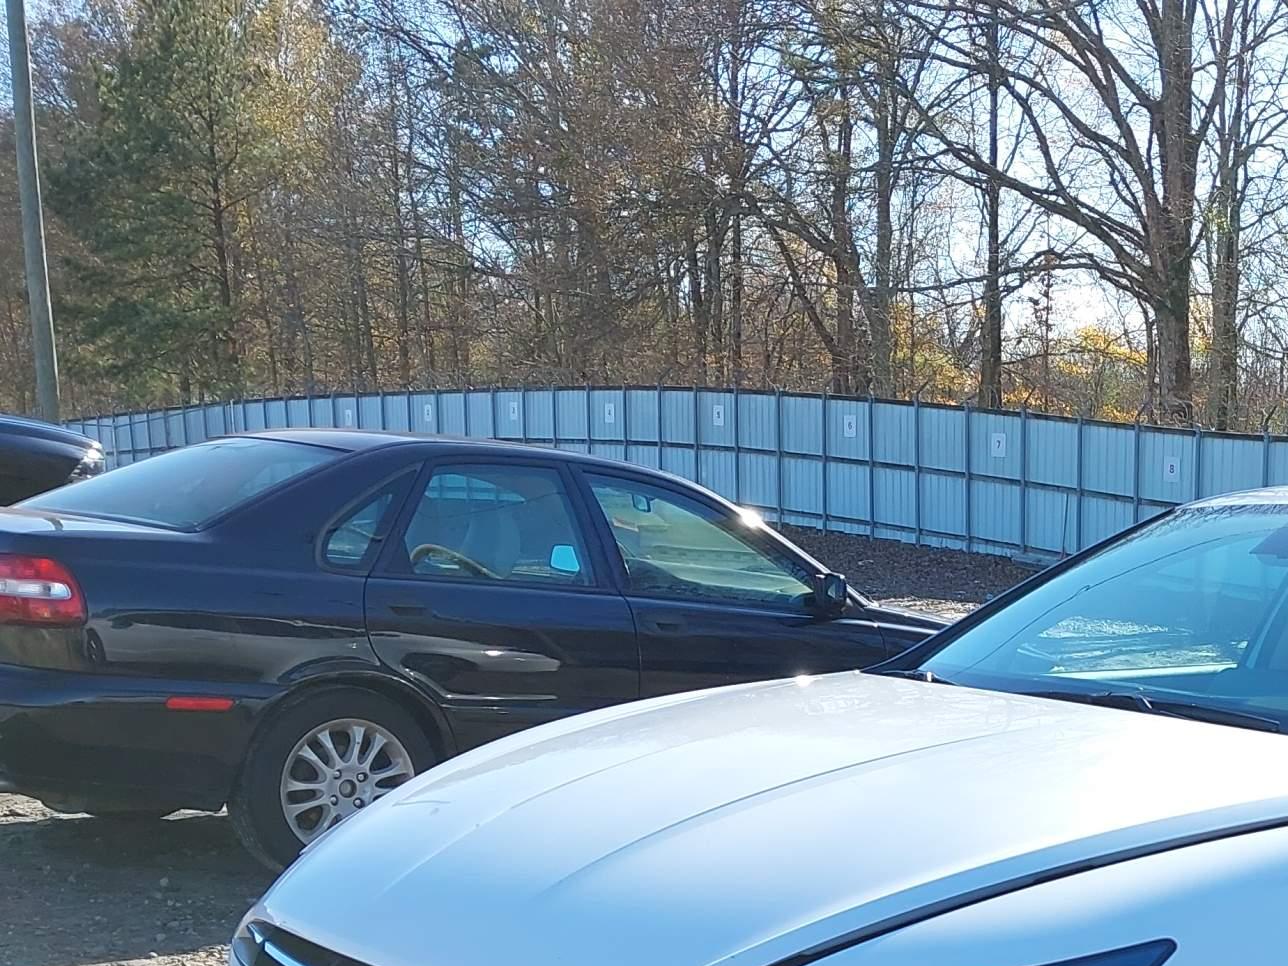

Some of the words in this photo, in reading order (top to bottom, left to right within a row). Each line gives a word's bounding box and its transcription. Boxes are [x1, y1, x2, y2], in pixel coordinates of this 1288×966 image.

[848, 421, 853, 430] 6
[996, 439, 1001, 449] 7
[1169, 464, 1175, 474] 8
